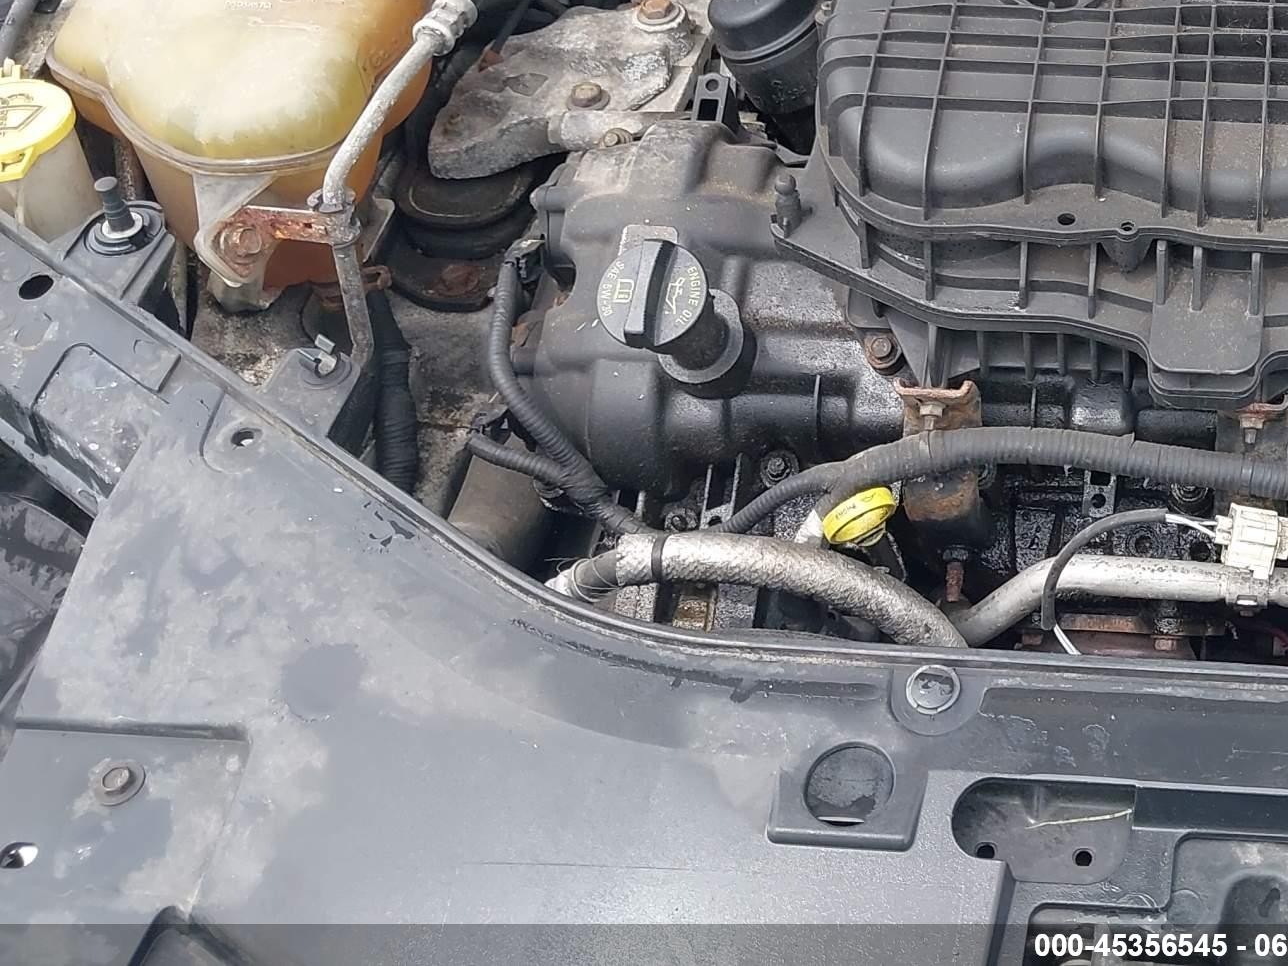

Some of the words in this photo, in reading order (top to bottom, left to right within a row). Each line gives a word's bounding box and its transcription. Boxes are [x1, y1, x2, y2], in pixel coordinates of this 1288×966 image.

[607, 260, 625, 280] SAE
[687, 265, 701, 307] ENGINE
[675, 309, 693, 325] OIL
